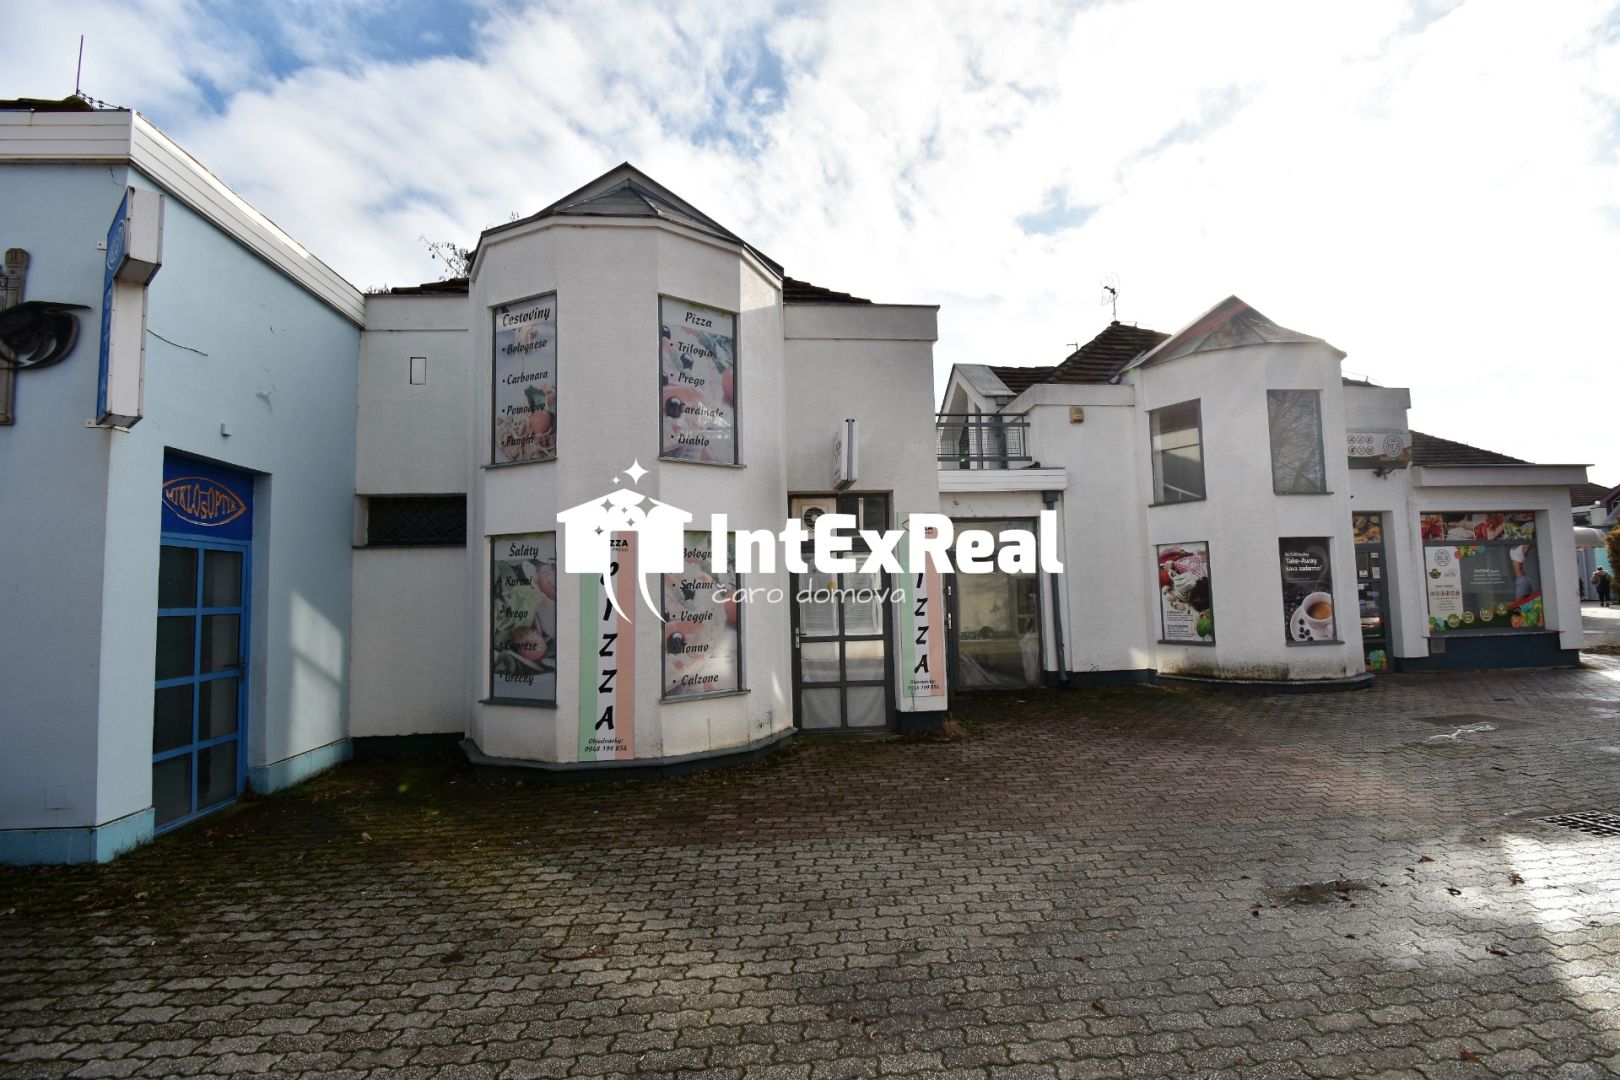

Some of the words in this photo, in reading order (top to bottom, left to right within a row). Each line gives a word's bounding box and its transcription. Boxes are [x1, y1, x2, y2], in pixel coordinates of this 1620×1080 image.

[503, 306, 551, 327] Cestoviny
[685, 311, 712, 328] Pizza
[507, 339, 548, 355] Bolognese
[678, 341, 713, 358] Trilogia
[507, 371, 548, 385] Carbonara
[678, 372, 705, 388] Prego
[507, 401, 546, 416] Pomodoro
[679, 402, 724, 418] Cardinale
[506, 432, 534, 447] Funghi
[678, 433, 710, 447] Diablo
[509, 542, 539, 558] Šaláty
[610, 539, 628, 547] ZZA
[683, 547, 711, 560] Bologn
[680, 579, 714, 590] Salami
[505, 606, 529, 619] Prego
[680, 610, 713, 623] Veggie
[914, 573, 930, 674] IZZA
[680, 642, 709, 654] Tonno
[681, 673, 719, 686] Calzone
